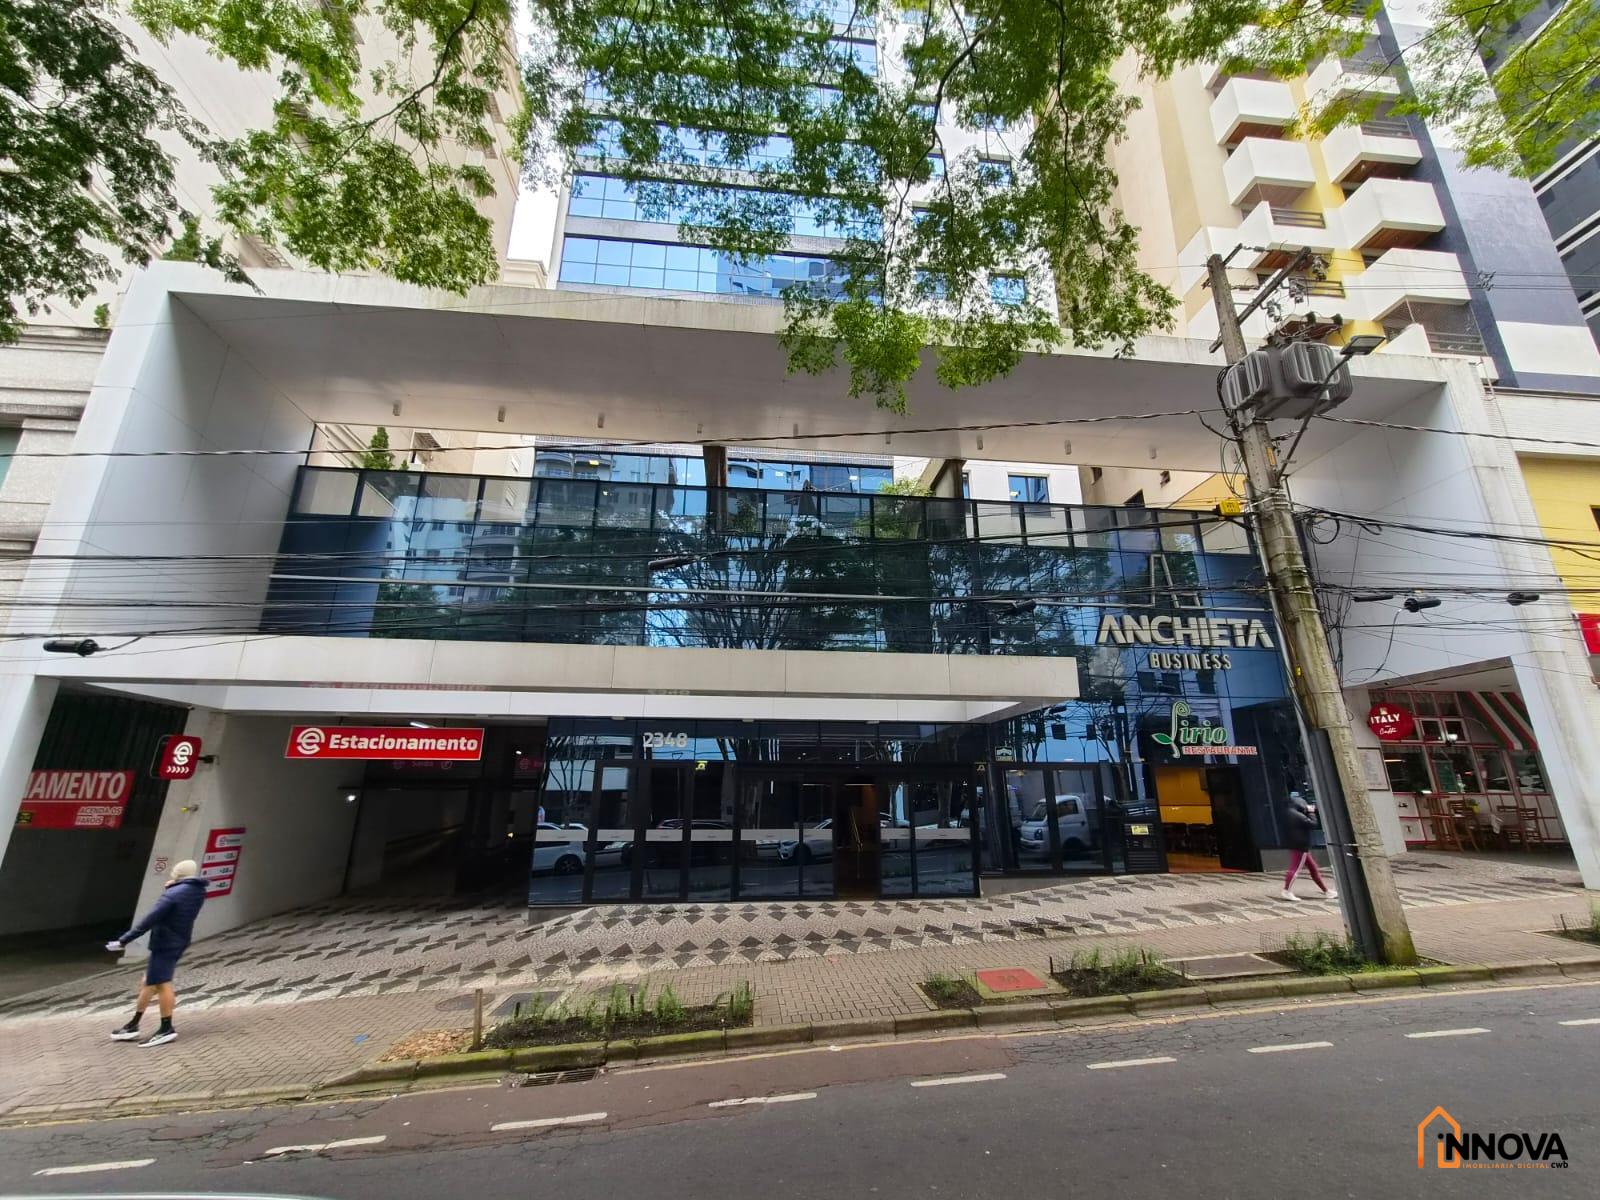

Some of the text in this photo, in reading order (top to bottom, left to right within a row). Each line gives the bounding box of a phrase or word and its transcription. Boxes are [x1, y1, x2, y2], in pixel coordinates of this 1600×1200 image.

[1097, 614, 1274, 648] ANCHIETA
[1149, 651, 1232, 670] BUSINESS
[1370, 713, 1400, 724] ITALY
[328, 734, 478, 751] Estacionamento
[643, 731, 688, 748] 2348
